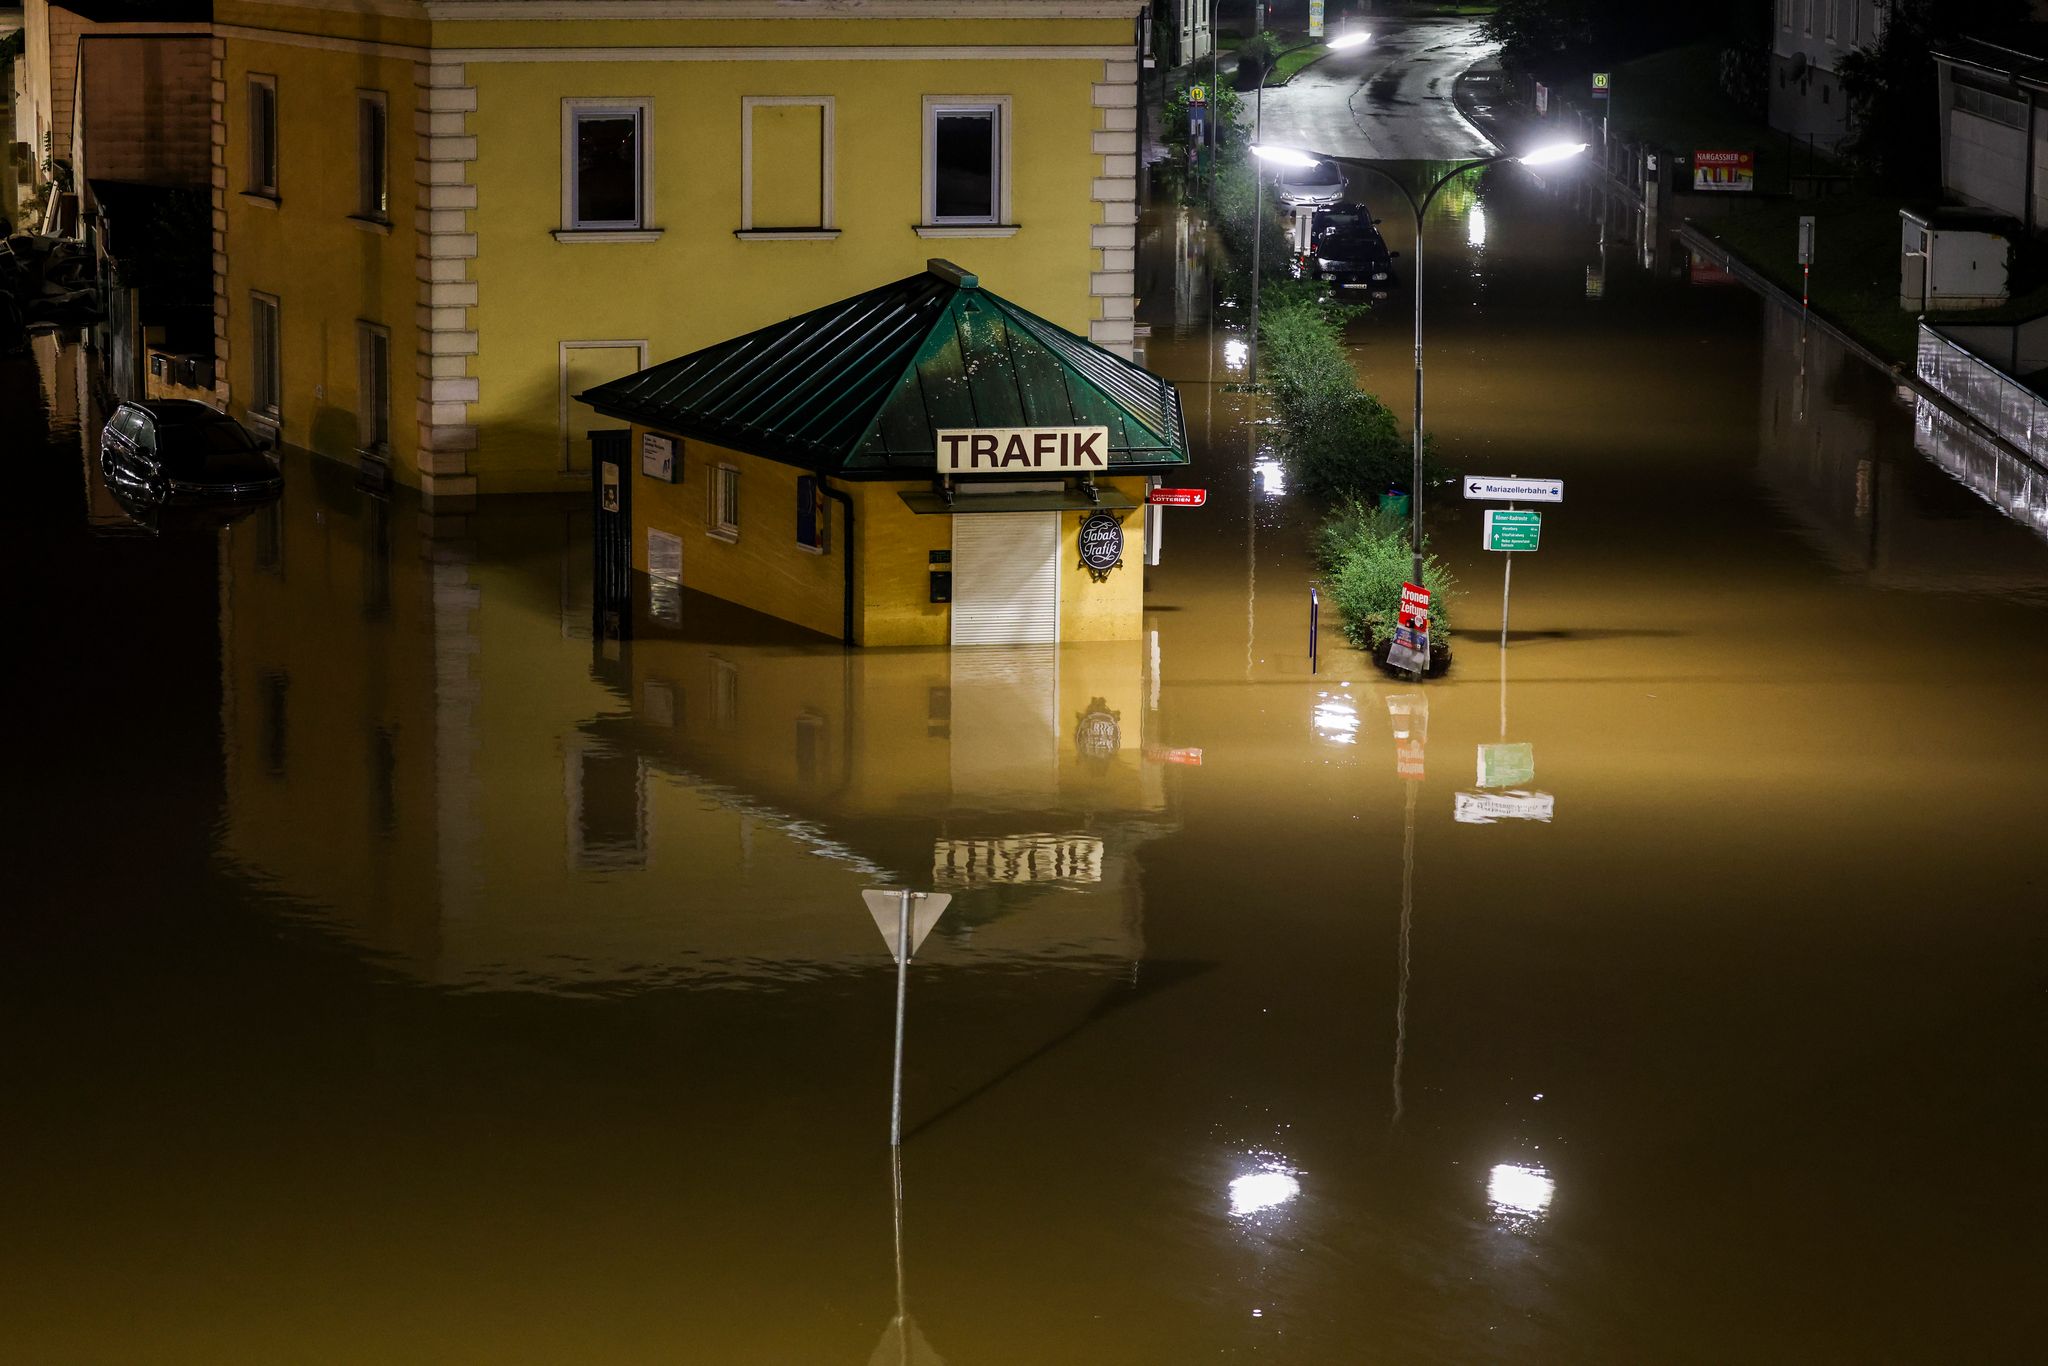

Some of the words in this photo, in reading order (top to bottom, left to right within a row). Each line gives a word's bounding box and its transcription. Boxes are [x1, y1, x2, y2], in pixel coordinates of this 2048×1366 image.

[941, 432, 1103, 468] TRAFIK
[1486, 485, 1547, 495] Mariazellerbahn
[1083, 527, 1119, 543] Tabak
[1084, 541, 1119, 558] Trafik
[1402, 587, 1429, 604] Kronen
[1400, 601, 1428, 619] Zeitung
